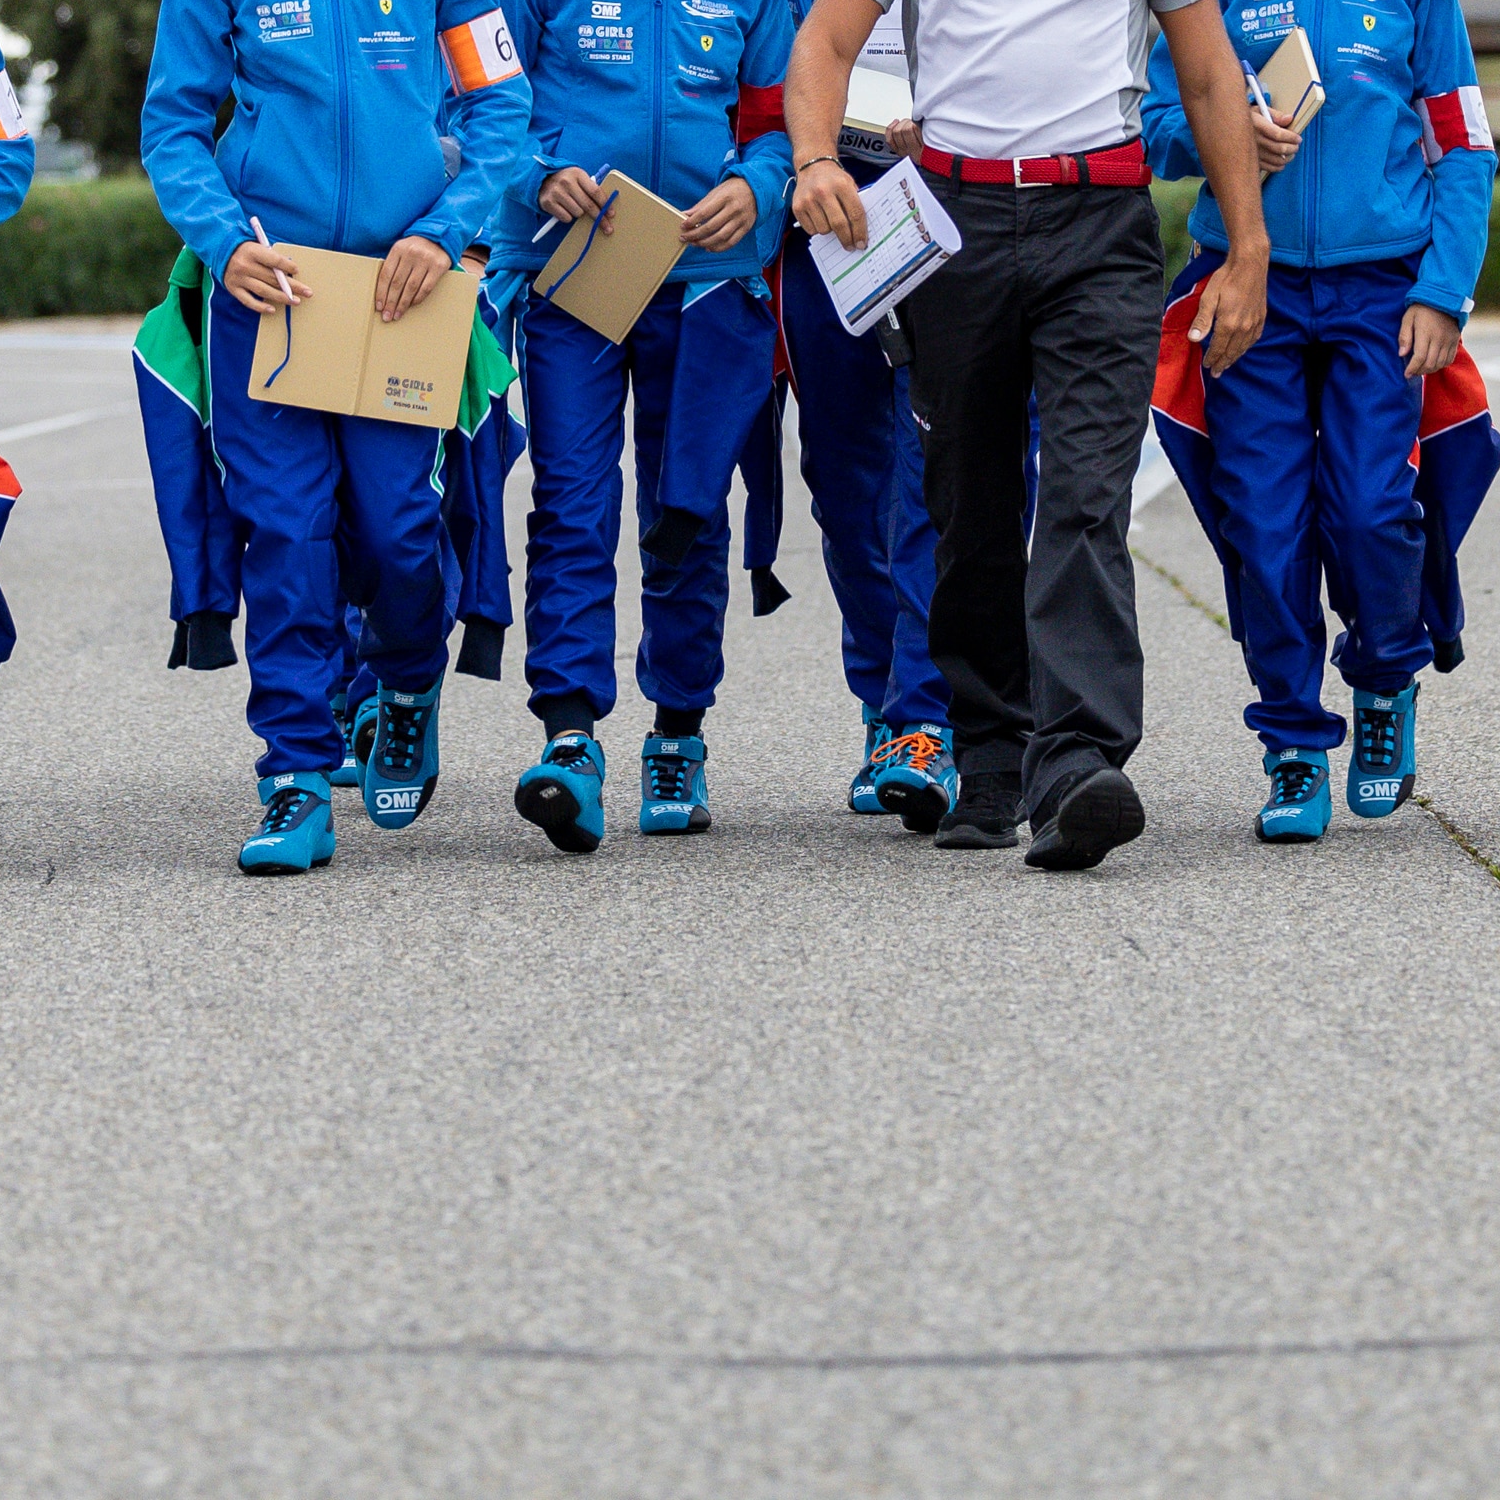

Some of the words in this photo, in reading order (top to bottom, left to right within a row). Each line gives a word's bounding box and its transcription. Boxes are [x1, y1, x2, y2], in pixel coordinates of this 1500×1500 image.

[272, 0, 311, 15] GIRLS
[591, 5, 621, 16] OMP
[1258, 1, 1295, 17] GIRLS
[259, 17, 277, 30] ON
[1242, 19, 1260, 32] ON
[595, 26, 634, 38] GIRLS
[495, 27, 513, 62] 6
[578, 38, 596, 49] ON
[840, 134, 885, 152] ISING
[402, 379, 433, 392] GIRLS
[394, 694, 415, 703] OMP
[1374, 700, 1393, 708] OMP
[921, 724, 942, 734] OMP
[1280, 750, 1298, 758] OMP
[274, 776, 295, 787] OMP
[1359, 782, 1400, 797] OMP
[376, 792, 421, 809] OMP
